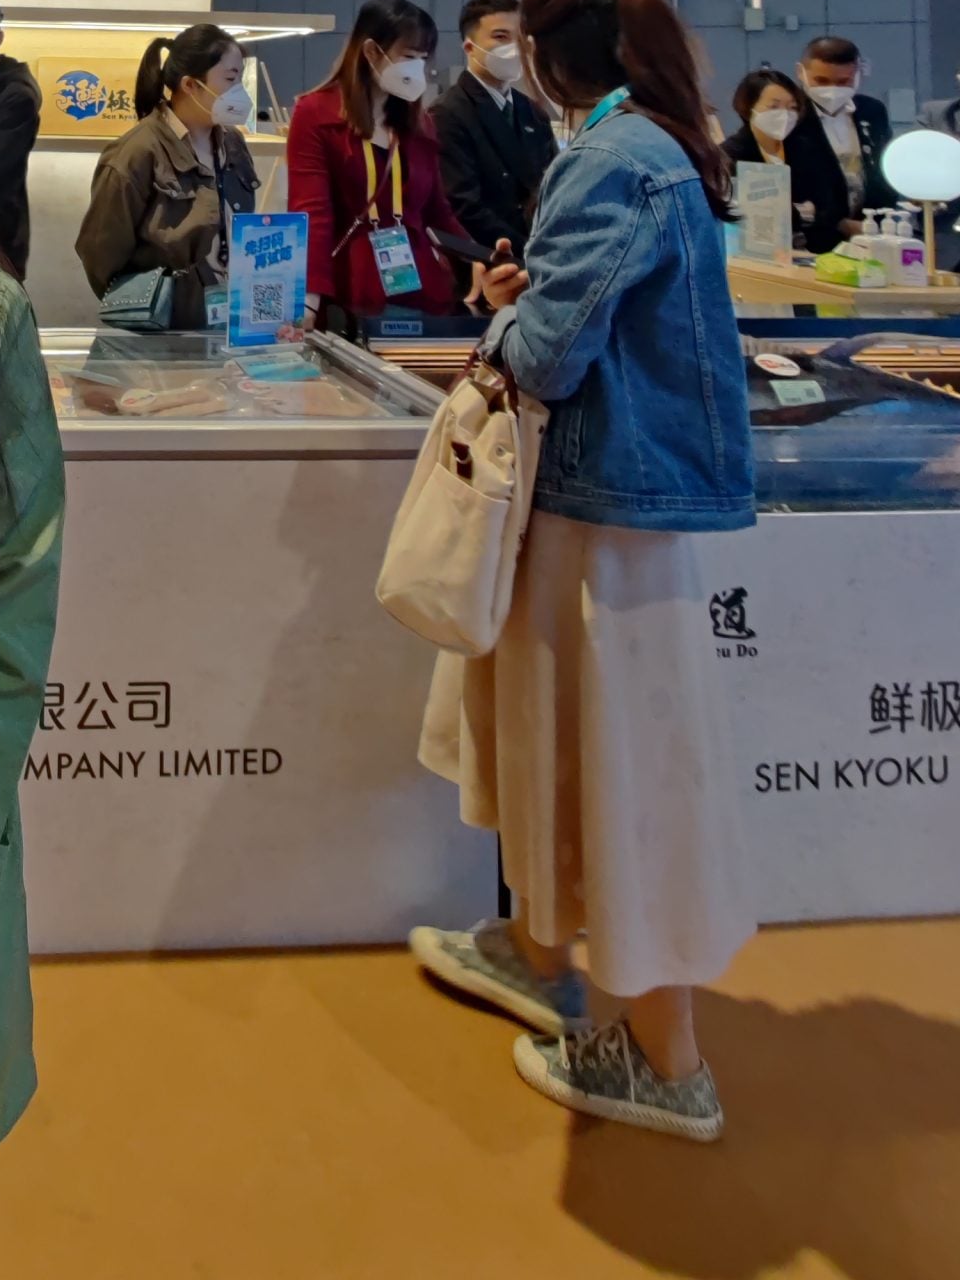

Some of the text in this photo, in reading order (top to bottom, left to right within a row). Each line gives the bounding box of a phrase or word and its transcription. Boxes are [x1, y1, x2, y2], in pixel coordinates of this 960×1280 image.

[736, 644, 758, 658] Do
[158, 748, 283, 778] LIMITED
[754, 755, 949, 793] SEN KYOKU
